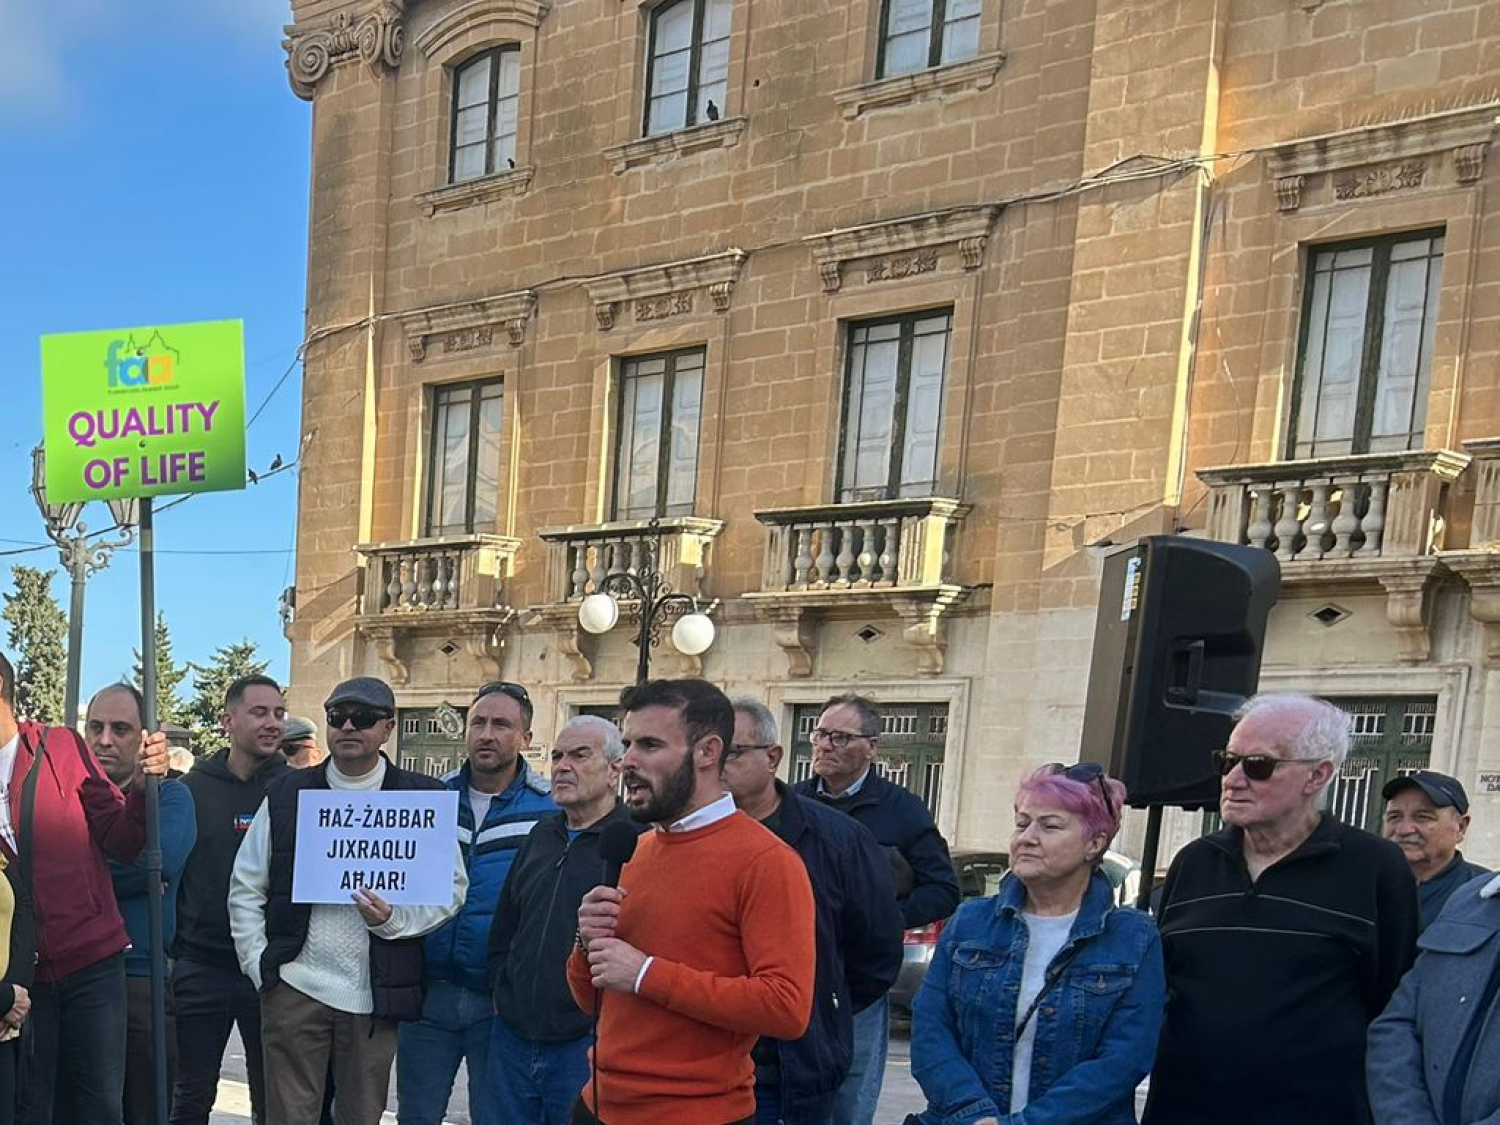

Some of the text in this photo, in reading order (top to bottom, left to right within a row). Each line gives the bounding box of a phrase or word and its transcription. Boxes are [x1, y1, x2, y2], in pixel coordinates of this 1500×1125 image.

[68, 400, 220, 445] QUALITY
[83, 451, 206, 489] OF LIFE
[318, 804, 435, 828] ĦAŻ-ŻABBAR
[327, 839, 416, 861] JIXRAQLU
[340, 870, 406, 890] AĦJAR!
